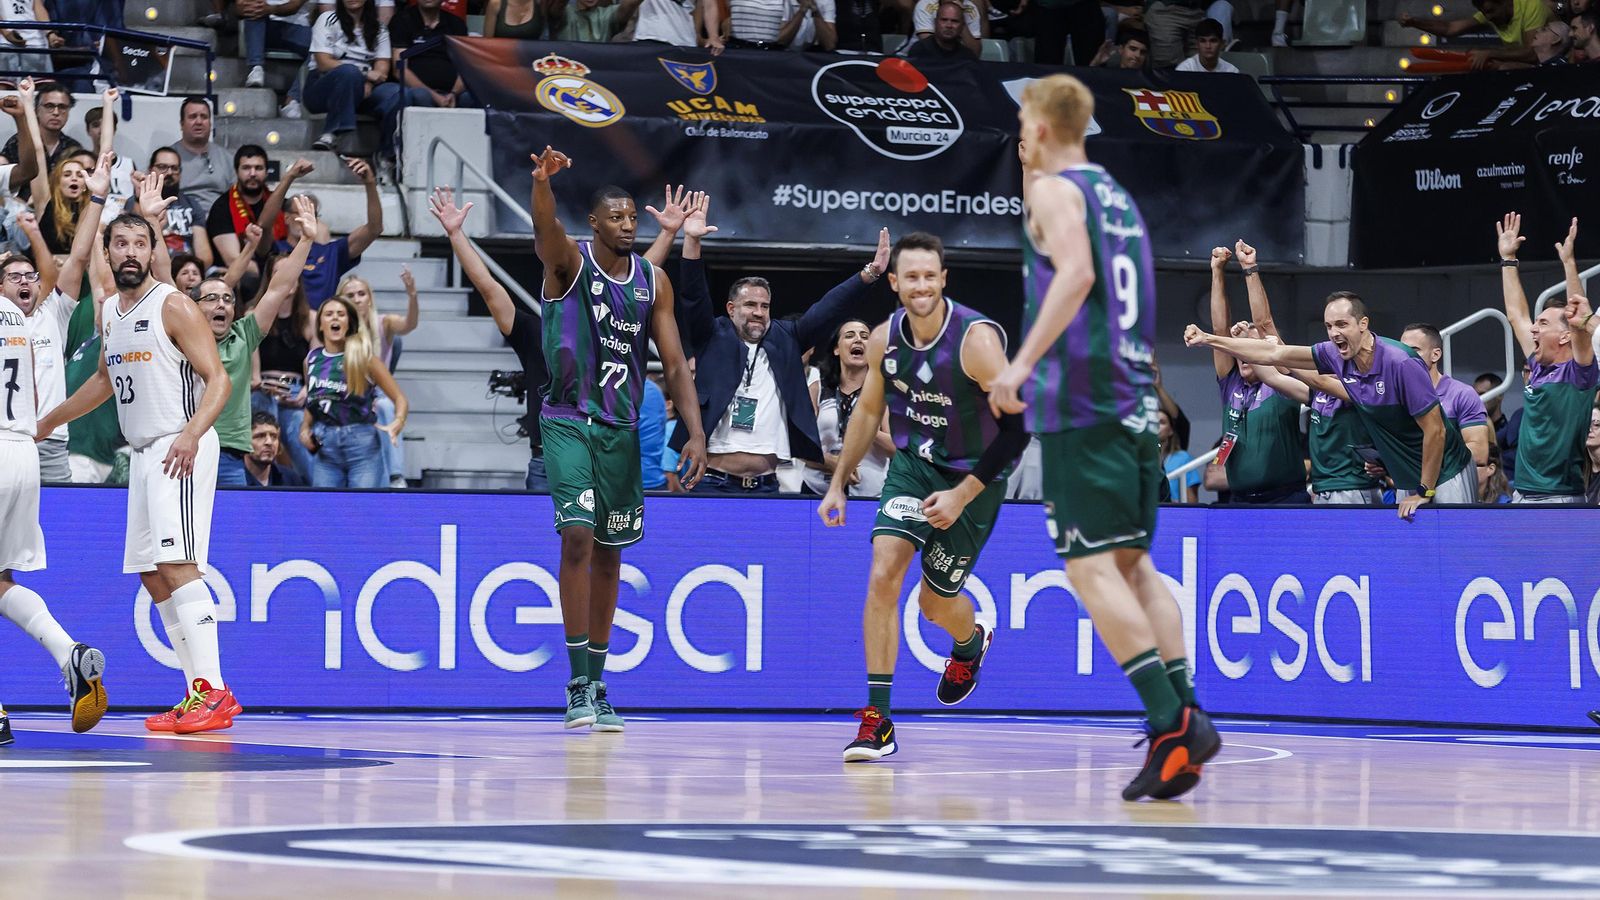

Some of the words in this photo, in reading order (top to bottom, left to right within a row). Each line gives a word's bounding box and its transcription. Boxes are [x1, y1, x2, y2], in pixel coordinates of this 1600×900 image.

[122, 46, 150, 57] Sector
[131, 58, 138, 67] 6
[666, 95, 759, 116] UCAM
[825, 93, 942, 109] supercopa
[845, 107, 952, 123] endesa
[706, 128, 719, 137] de
[720, 128, 769, 139] Baloncesto
[890, 130, 931, 142] Murcia
[1548, 146, 1584, 170] renfe
[1415, 168, 1462, 191] Wilson
[1477, 162, 1525, 178] azulmarino
[774, 184, 1023, 216] #SupercopaEndes
[1112, 254, 1139, 331] 9
[598, 361, 629, 390] 77
[3, 358, 21, 421] 7
[115, 375, 135, 404] 23
[134, 524, 764, 673] endesa
[1454, 576, 1600, 690] en
